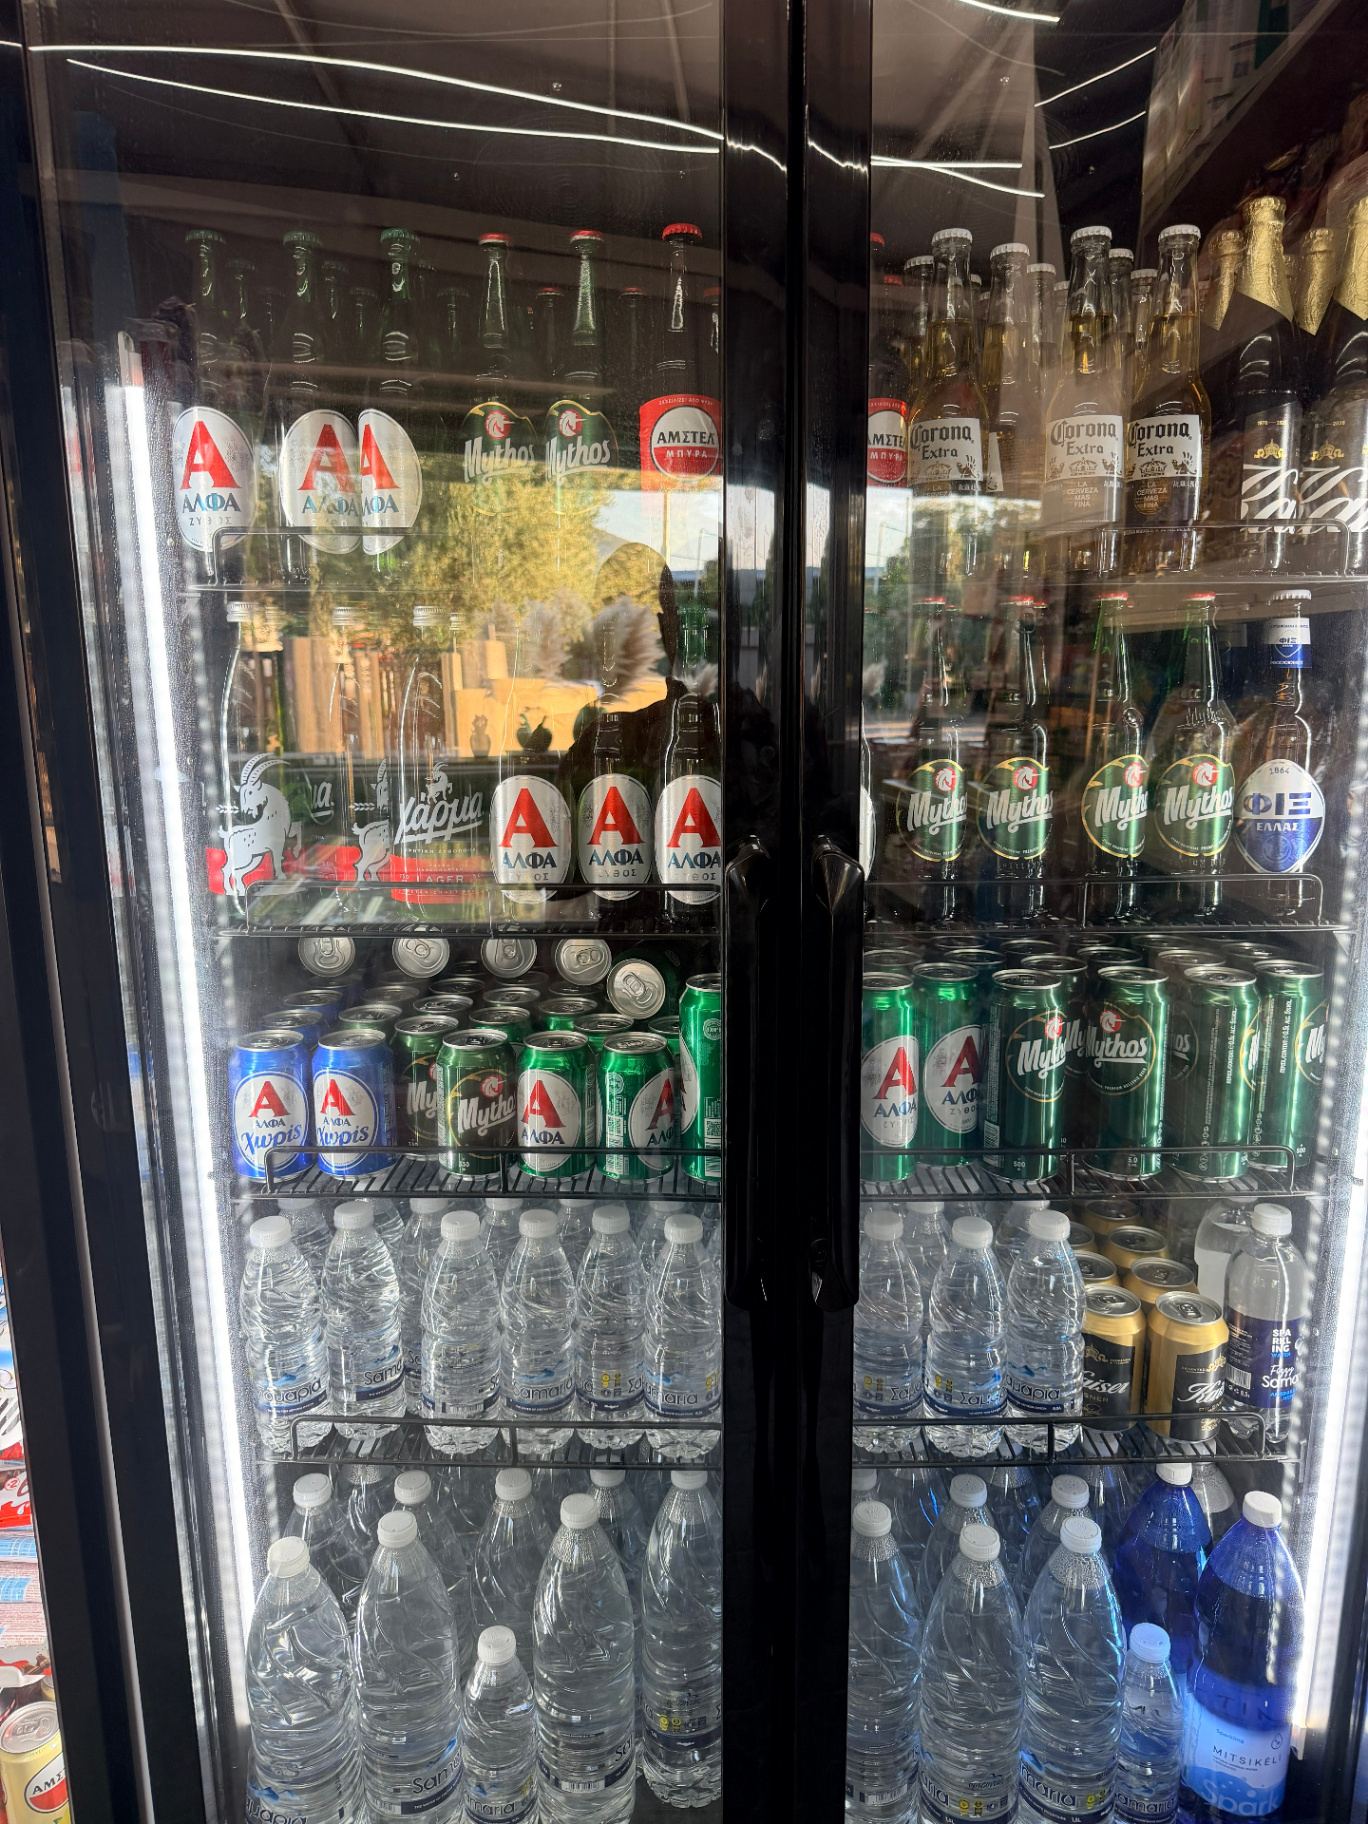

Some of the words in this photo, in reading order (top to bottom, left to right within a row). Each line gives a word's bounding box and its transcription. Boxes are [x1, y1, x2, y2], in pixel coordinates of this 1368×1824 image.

[656, 430, 716, 445] ΑΜΣΤΕΛ
[867, 433, 907, 448] ΜΣΤΕ
[910, 425, 974, 450] Corona
[1051, 420, 1117, 447] Corona
[1127, 421, 1190, 448] Corona
[666, 449, 708, 458] ΜΠΥΡΑ
[921, 444, 959, 460] Extra
[1066, 440, 1105, 456] Extra
[1137, 442, 1174, 457] Extra
[464, 436, 535, 485] Mythos
[545, 435, 611, 485] Mythos
[1066, 487, 1099, 495] CERVEZA
[1136, 487, 1168, 496] CERVEZA
[182, 492, 241, 514] ΑΛΦΑ
[361, 493, 400, 517] ΛΦΑ
[1143, 501, 1159, 509] FINA
[1269, 767, 1290, 775] 1864
[1163, 784, 1234, 830] Mythos
[1243, 792, 1312, 816] ΦΙΞ
[1256, 822, 1300, 832] ΕΛΛΑΣ
[501, 851, 557, 869] ΑΛΦΑ
[589, 848, 644, 867] ΑΛΦΑ
[668, 851, 722, 869] ΑΛΦΑ
[416, 875, 464, 883] LAGER
[1086, 1026, 1148, 1068] Mythos
[941, 1087, 978, 1105] ΑΛΦ
[873, 1097, 917, 1118] ΑΛΦΑ
[949, 1104, 977, 1116] ΖΥΘΟ
[255, 1117, 287, 1129] ΑΛΦΑ
[322, 1116, 352, 1127] ΑΛΦΑ
[521, 1129, 566, 1146] ΑΛΦΑ
[646, 1126, 674, 1148] ΑΛΦ
[1272, 1328, 1292, 1337] SPA
[1272, 1337, 1292, 1345] RKL
[1271, 1345, 1290, 1353] ING
[513, 1373, 574, 1400] Samaria
[1261, 1372, 1301, 1389] Sama
[1083, 1393, 1109, 1403] SNER
[32, 1770, 64, 1796] ΑΜΣ
[1020, 1762, 1076, 1807] maria
[1201, 1779, 1280, 1817] Spark
